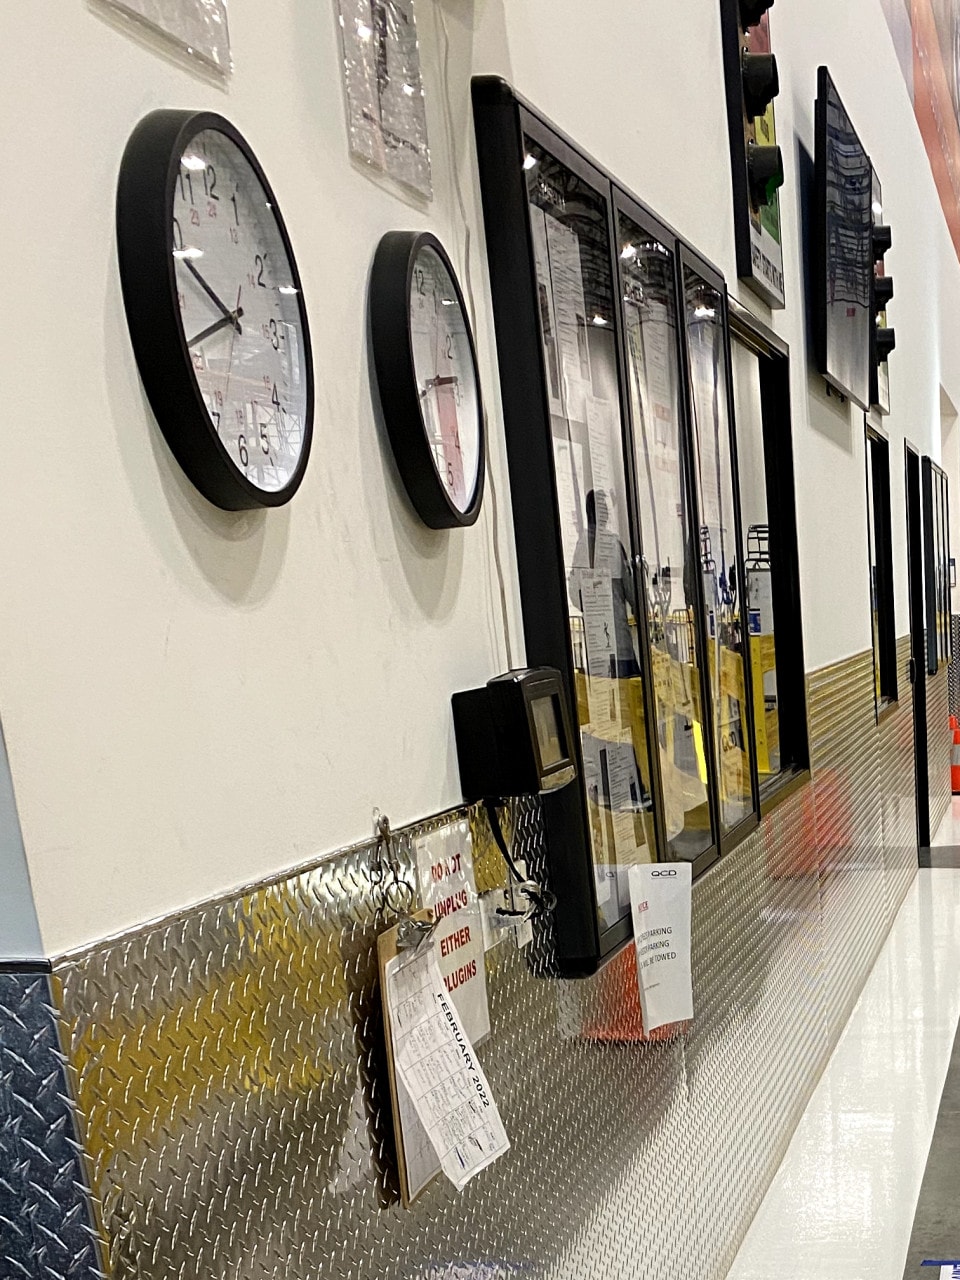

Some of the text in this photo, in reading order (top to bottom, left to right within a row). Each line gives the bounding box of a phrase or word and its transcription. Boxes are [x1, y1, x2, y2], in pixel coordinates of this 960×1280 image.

[203, 165, 219, 200] 12
[231, 194, 239, 226] 1
[255, 254, 266, 288] 2
[270, 318, 280, 352] 3
[272, 383, 281, 413] 4
[238, 434, 249, 467] 6
[259, 422, 271, 455] 5
[447, 462, 454, 486] 5
[431, 862, 443, 881] DO
[651, 869, 677, 877] QCD
[434, 889, 468, 919] UNPLUG
[440, 926, 471, 957] EITHER
[655, 951, 677, 963] TOWED
[437, 993, 490, 1108] FEBRUARY 2022
